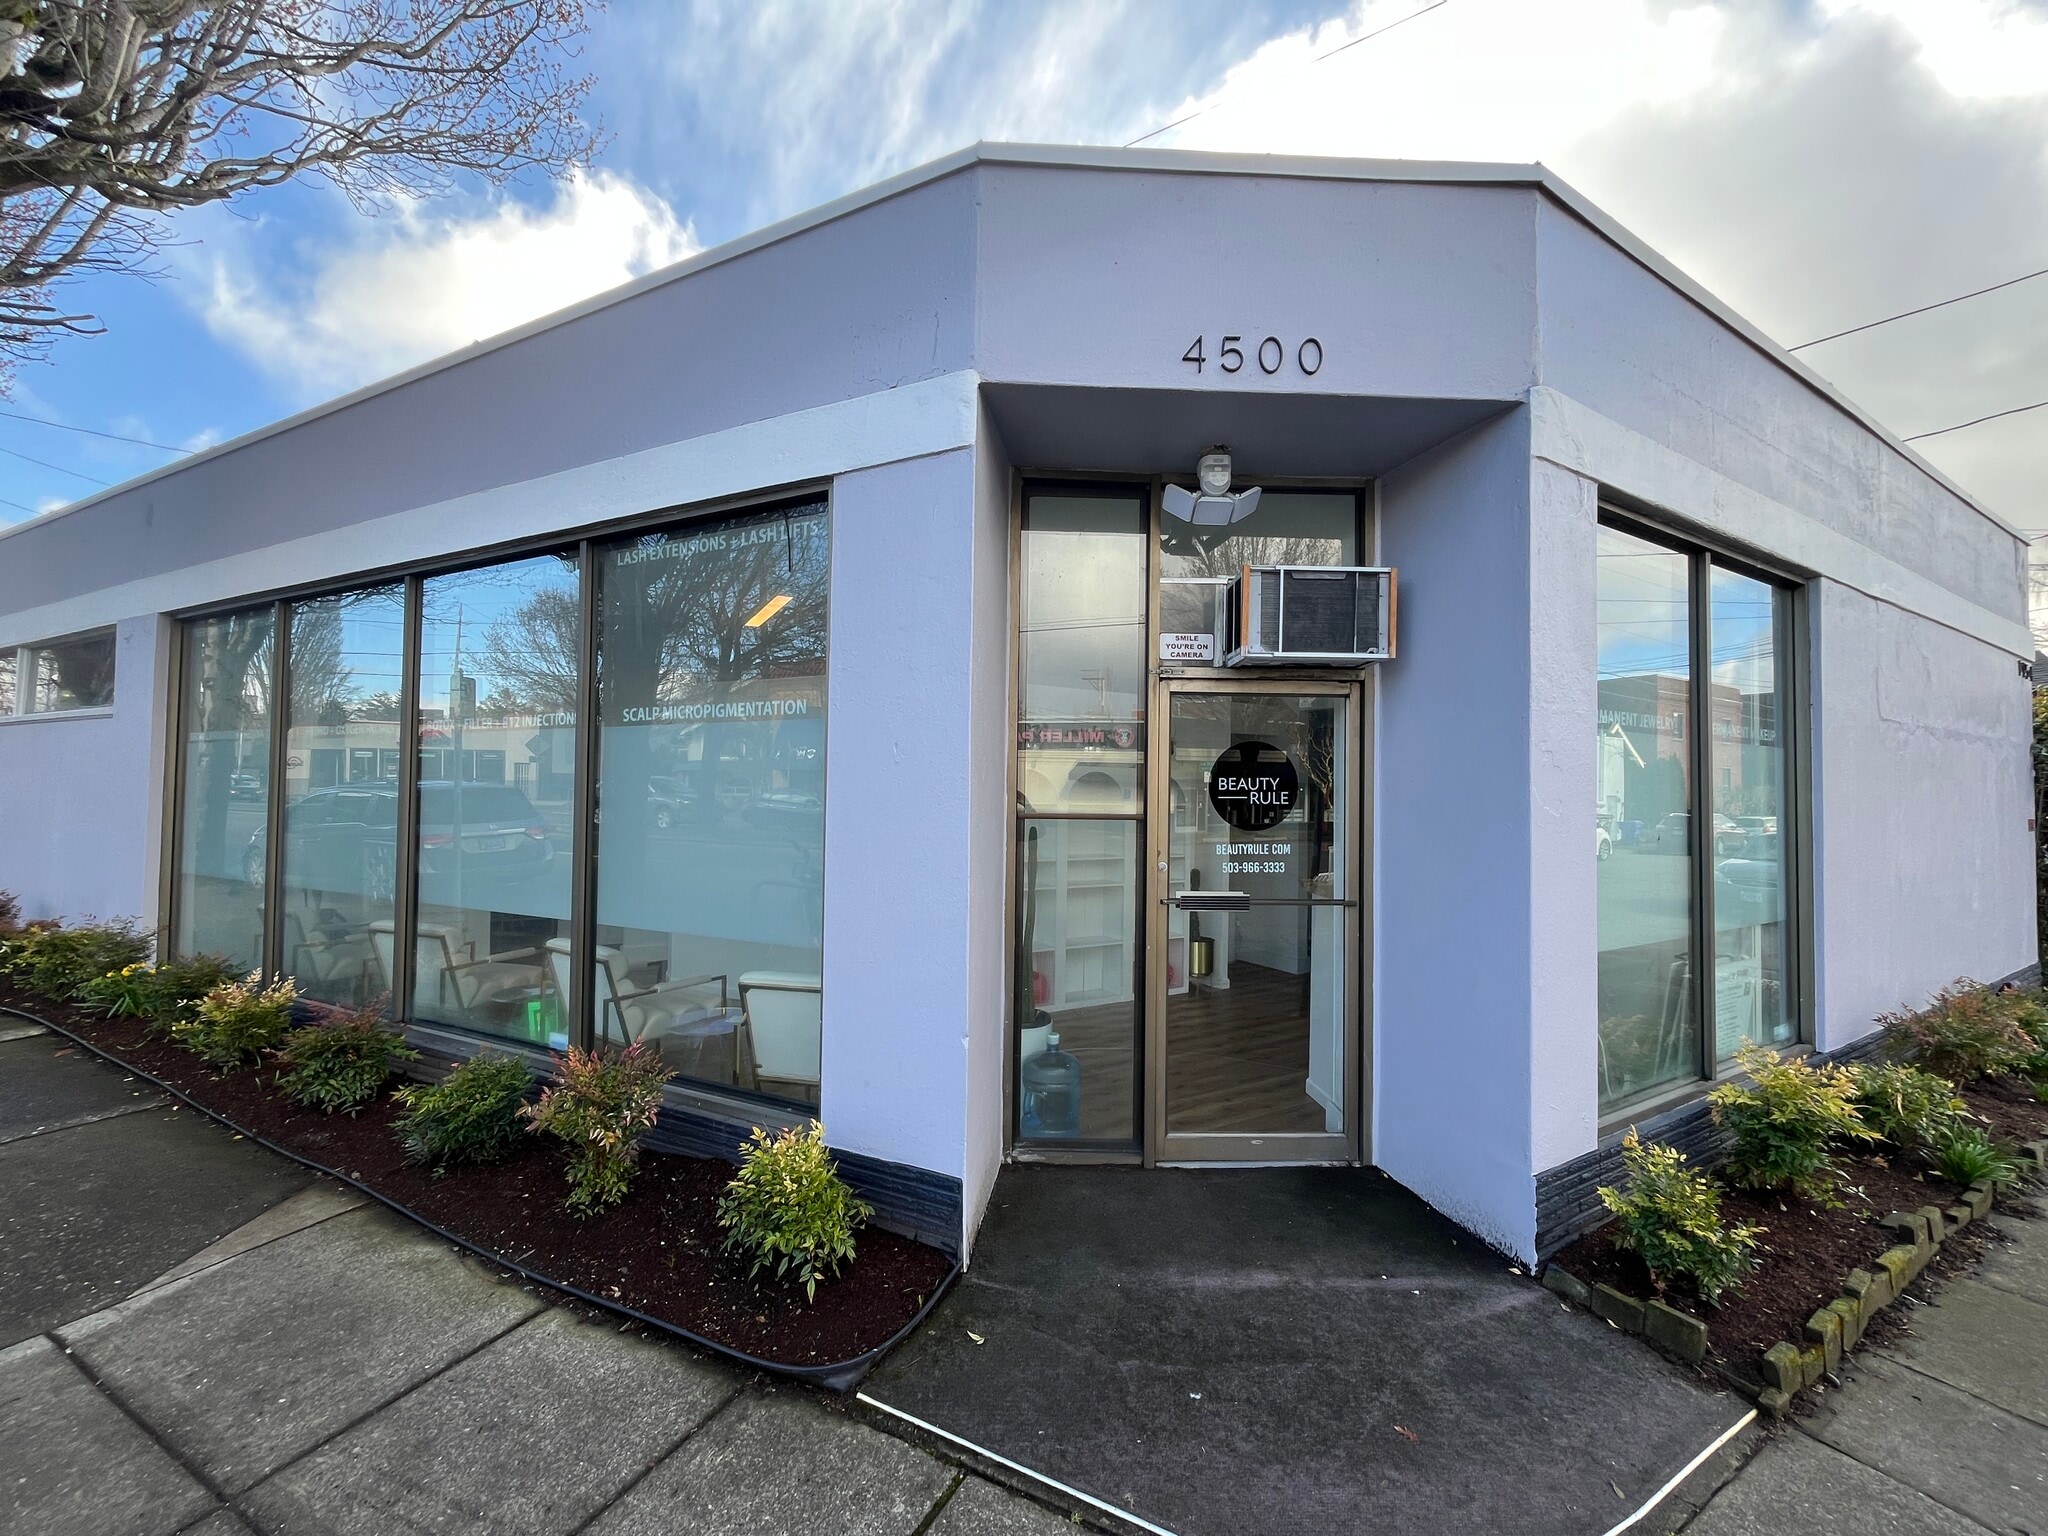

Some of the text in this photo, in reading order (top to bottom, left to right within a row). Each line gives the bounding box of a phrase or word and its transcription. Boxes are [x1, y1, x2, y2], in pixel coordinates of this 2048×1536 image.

[1182, 334, 1324, 376] 4500
[617, 547, 647, 567] LASH
[651, 536, 726, 561] EXTENSIONS
[740, 527, 778, 548] LASH
[622, 699, 807, 722] SCALP MICROPIGMENTATION
[464, 717, 492, 730] FILLER
[1218, 777, 1280, 791] BEAUTY
[1250, 791, 1289, 805] RULE
[1222, 862, 1285, 873] 503-966-3333
